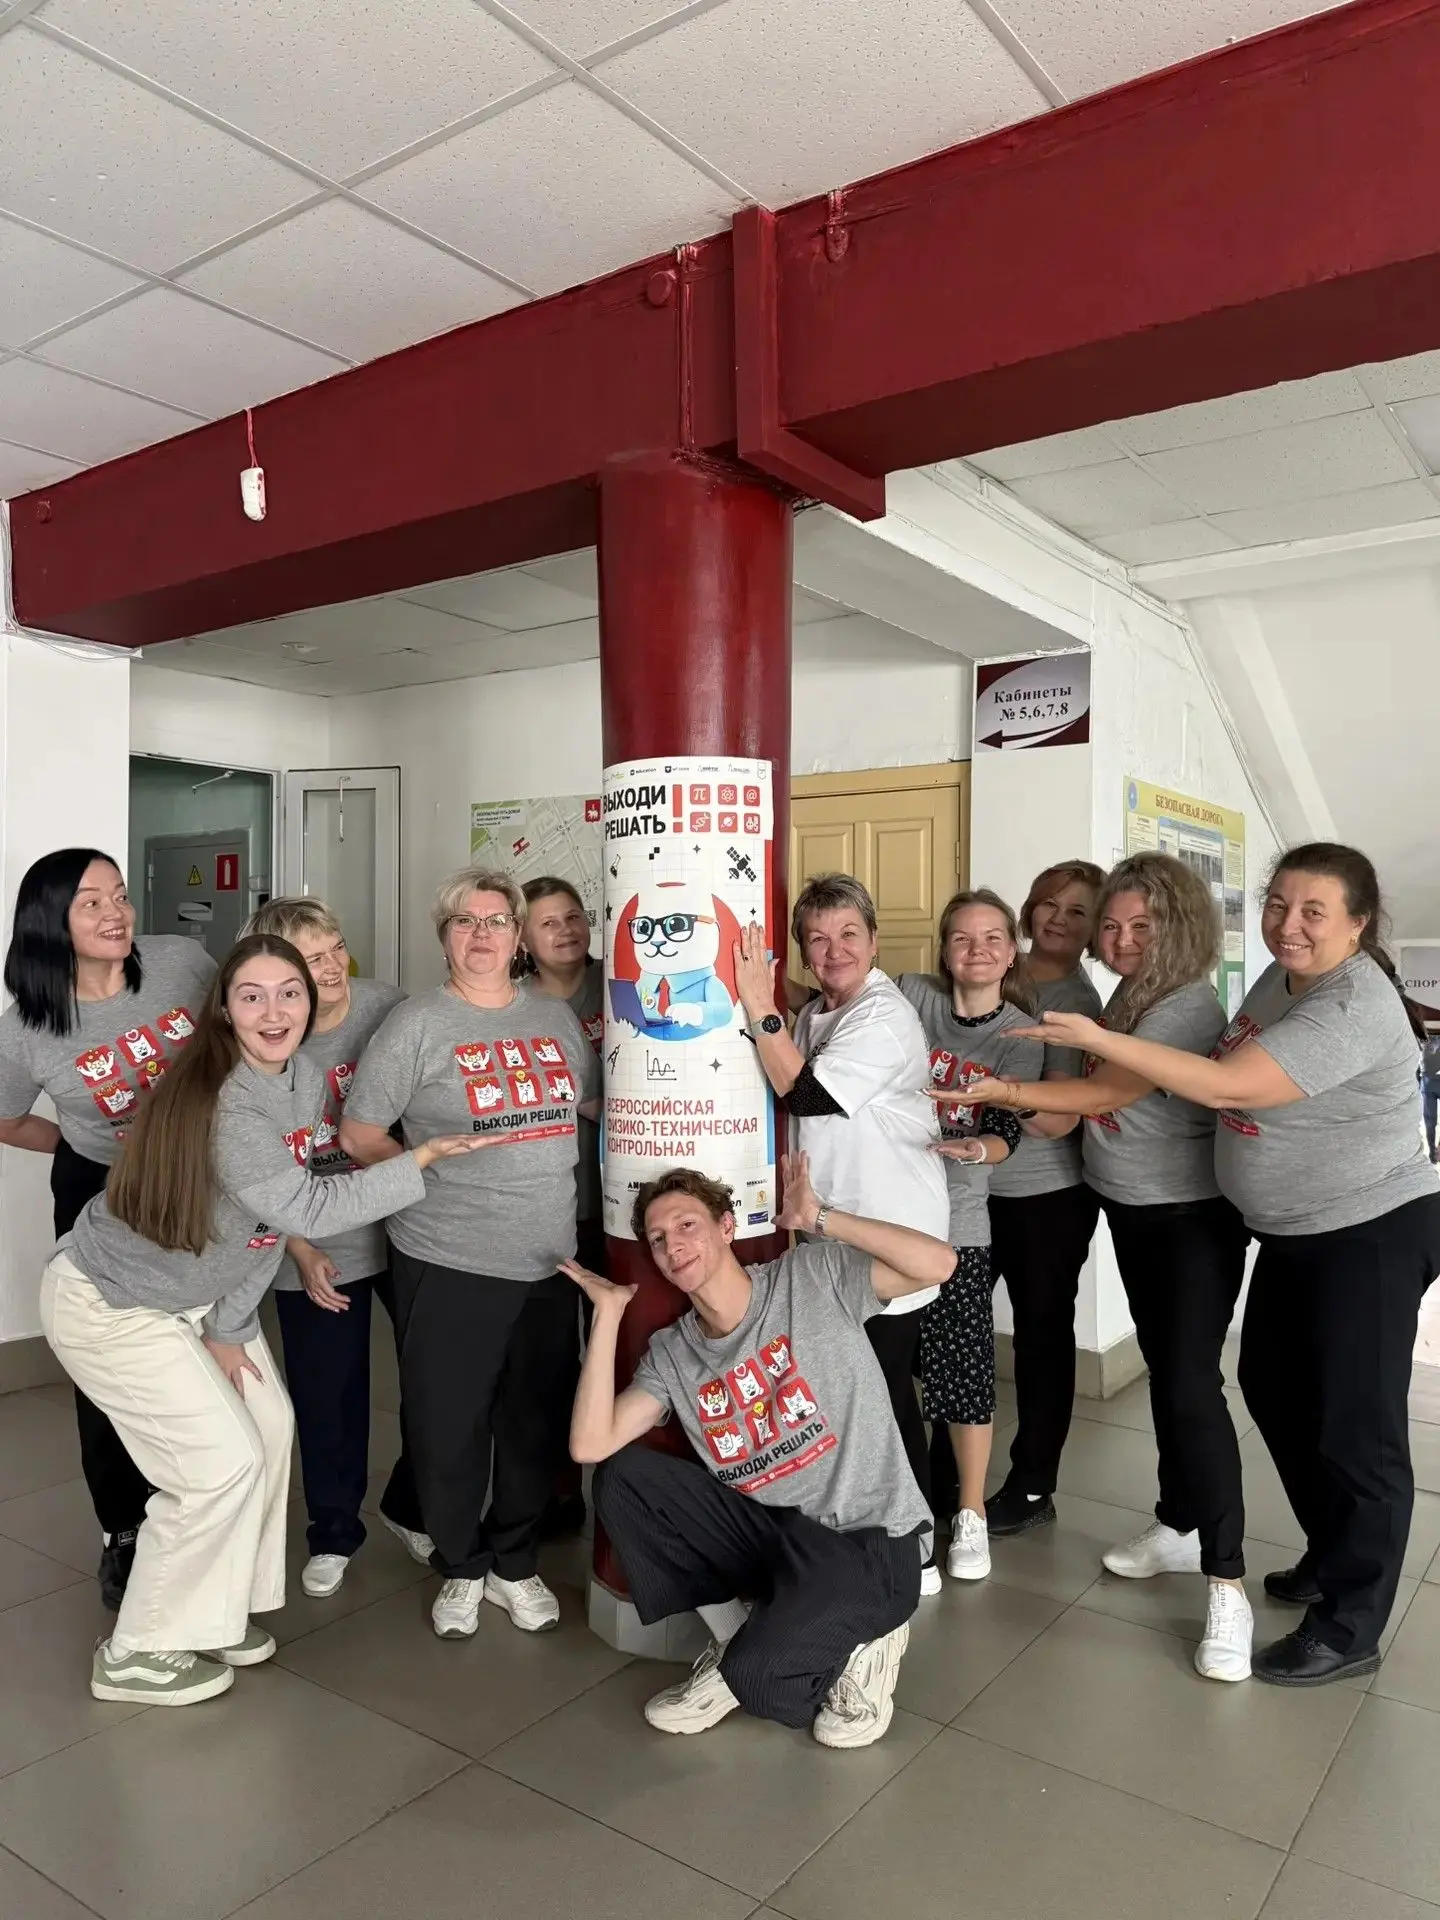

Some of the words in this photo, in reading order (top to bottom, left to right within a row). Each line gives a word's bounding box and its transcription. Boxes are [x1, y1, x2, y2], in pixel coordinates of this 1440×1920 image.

[994, 686, 1072, 704] Кабинеты
[1000, 708, 1016, 721] №
[1019, 702, 1069, 720] 5,6,7,8
[1155, 794, 1200, 818] БЕЗОПАСНАЯ
[1200, 808, 1224, 826] ДОРОГА
[605, 814, 666, 841] РЕШАТЬ
[1404, 979, 1440, 988] СПОР
[473, 1112, 527, 1132] ВЫХОДИ
[607, 1137, 695, 1156] КОНТРОЛЬНАЯ
[717, 1453, 773, 1482] ВЫХОДИ
